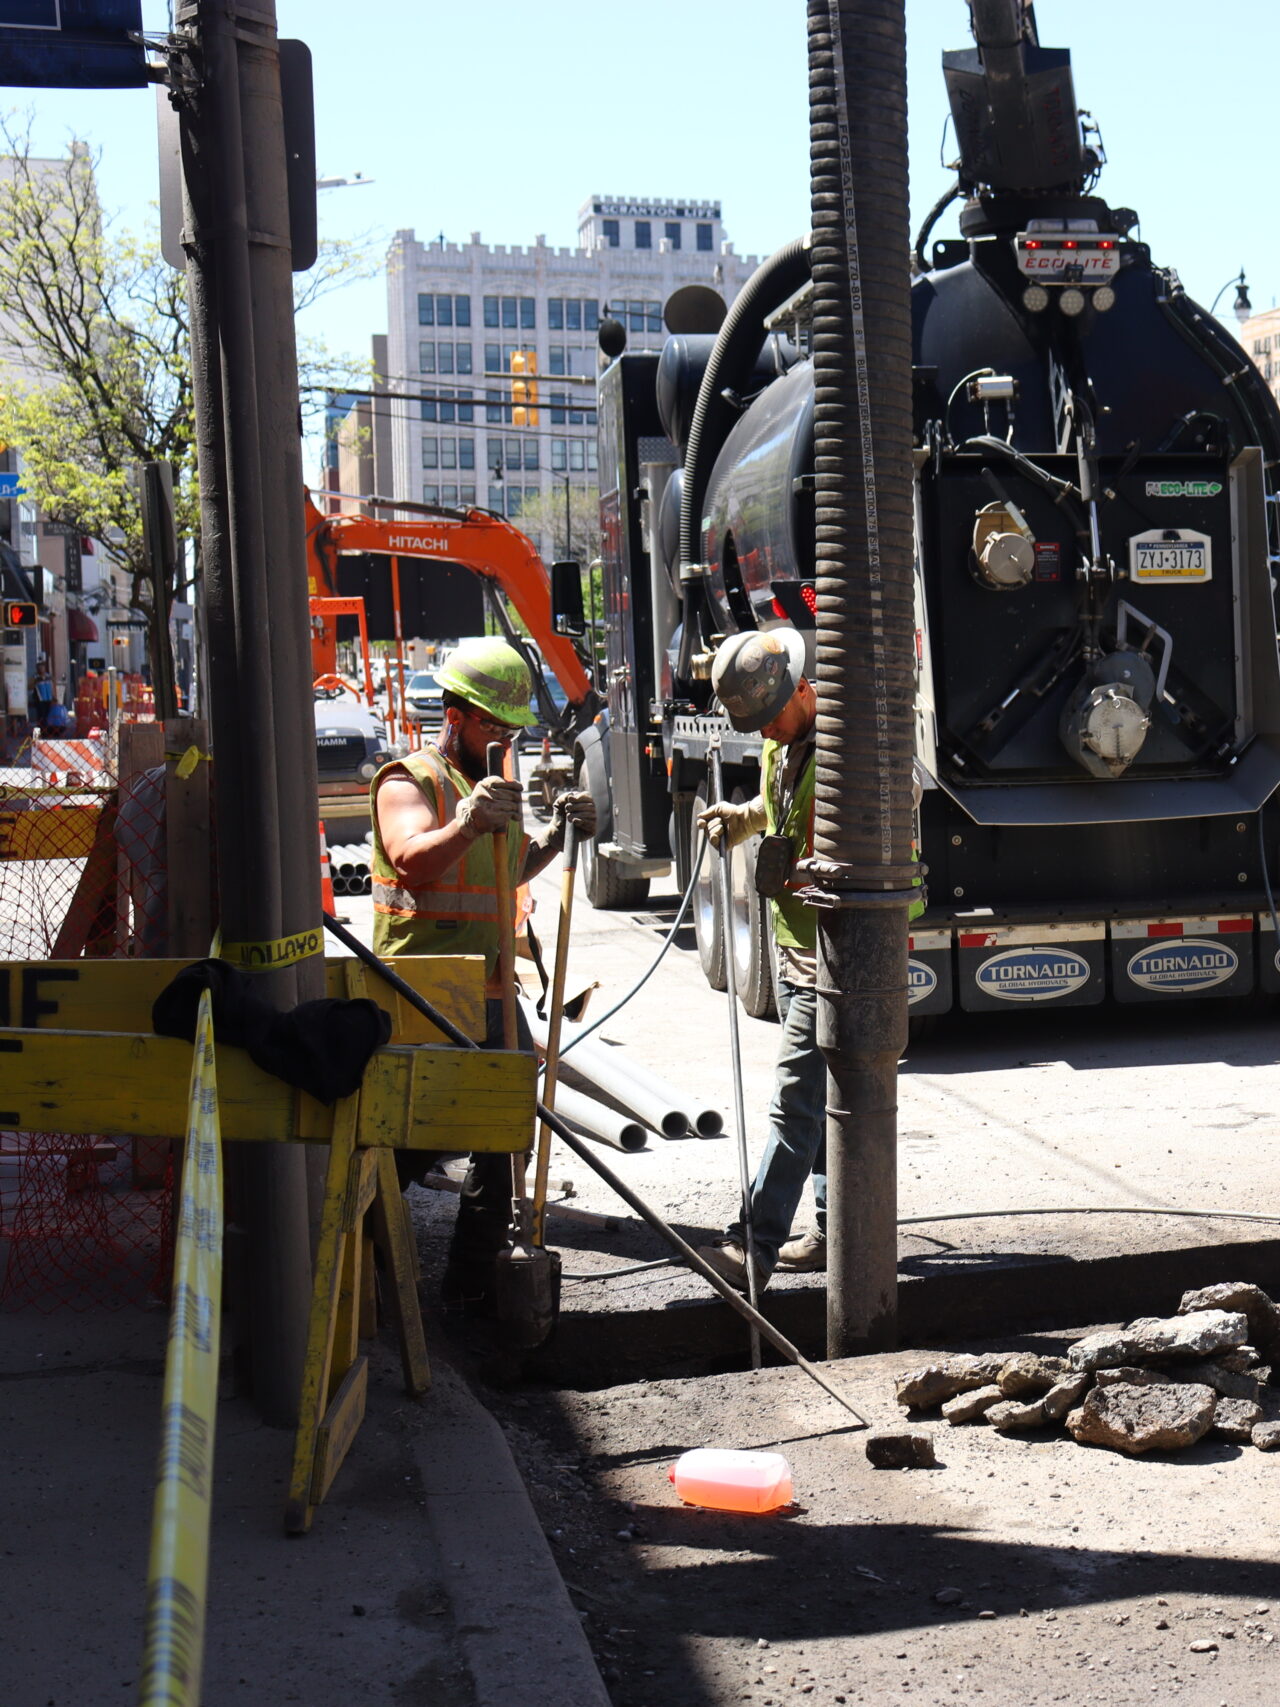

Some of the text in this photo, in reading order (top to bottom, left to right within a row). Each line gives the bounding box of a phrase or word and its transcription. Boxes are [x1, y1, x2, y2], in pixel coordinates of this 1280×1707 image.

[839, 125, 855, 230] FORSAFLEX
[601, 205, 716, 219] SCRANTON LIFE
[848, 243, 862, 311] MT70-800
[861, 423, 873, 474] HARDWALL
[865, 477, 876, 517] SUCTION
[1160, 483, 1208, 496] ECO-LITE
[388, 535, 448, 551] HITACHI
[317, 738, 347, 746] HAMM
[988, 962, 1080, 981] TORNADO
[1139, 953, 1228, 973] TORNADO
[999, 979, 1069, 989] GLOBAL HYDROVACS
[1149, 973, 1176, 981] GLOBAL
